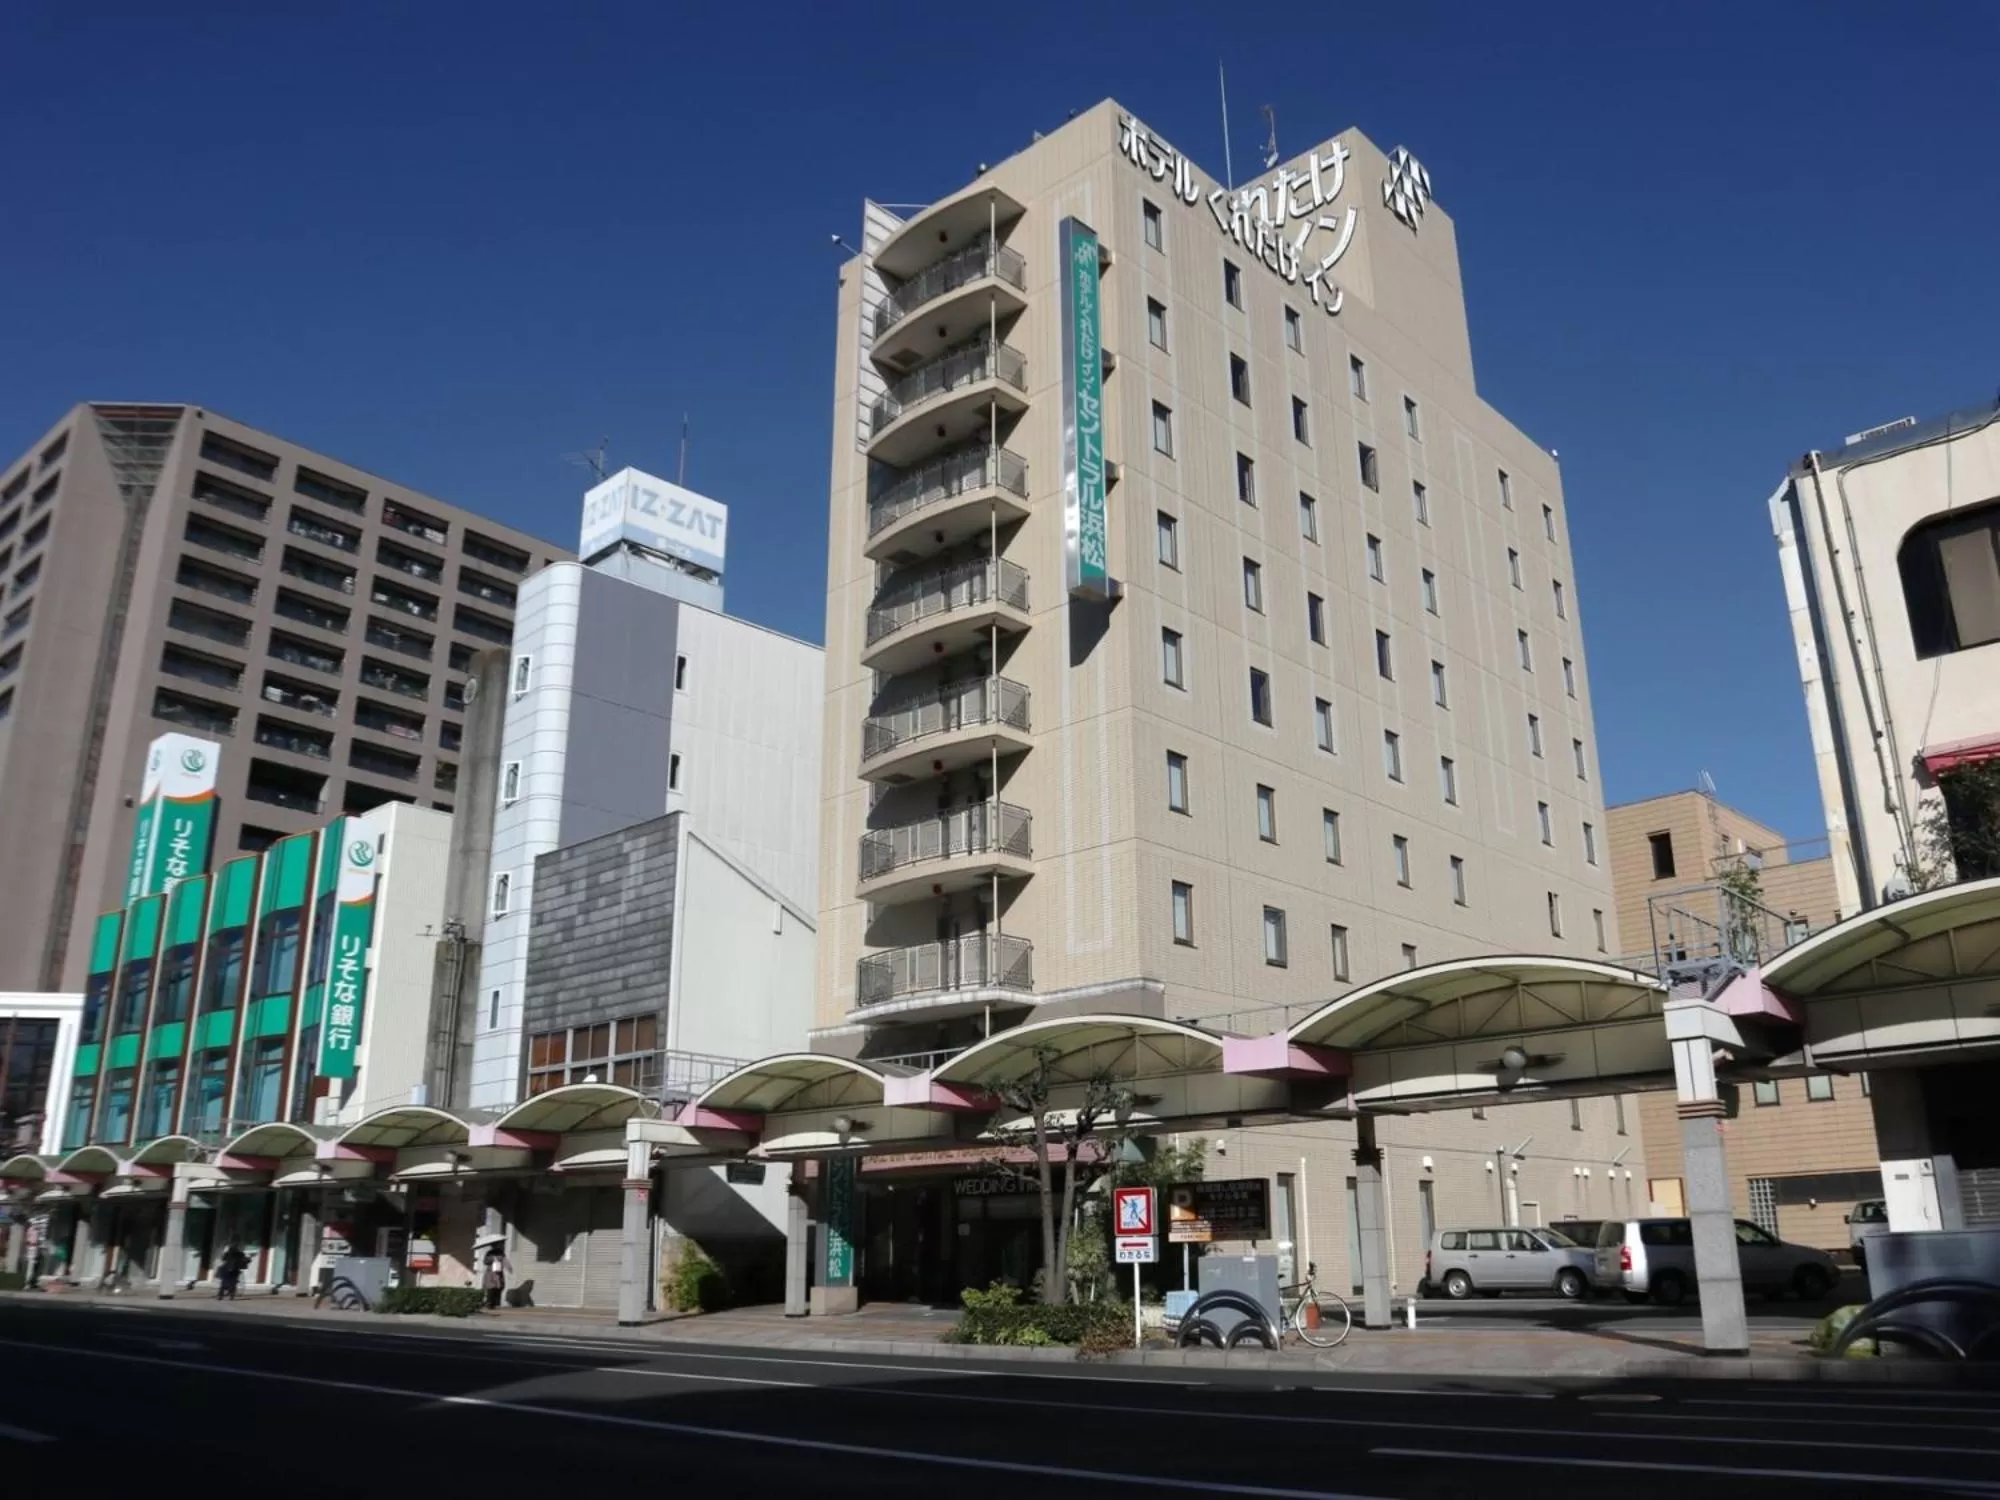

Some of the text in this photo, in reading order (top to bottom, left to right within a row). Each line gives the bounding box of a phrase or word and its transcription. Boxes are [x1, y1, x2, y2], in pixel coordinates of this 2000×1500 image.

[328, 934, 361, 1051] りそな銀行
[953, 1175, 1017, 1196] WEDDING
[1119, 1250, 1151, 1260] わたるな
